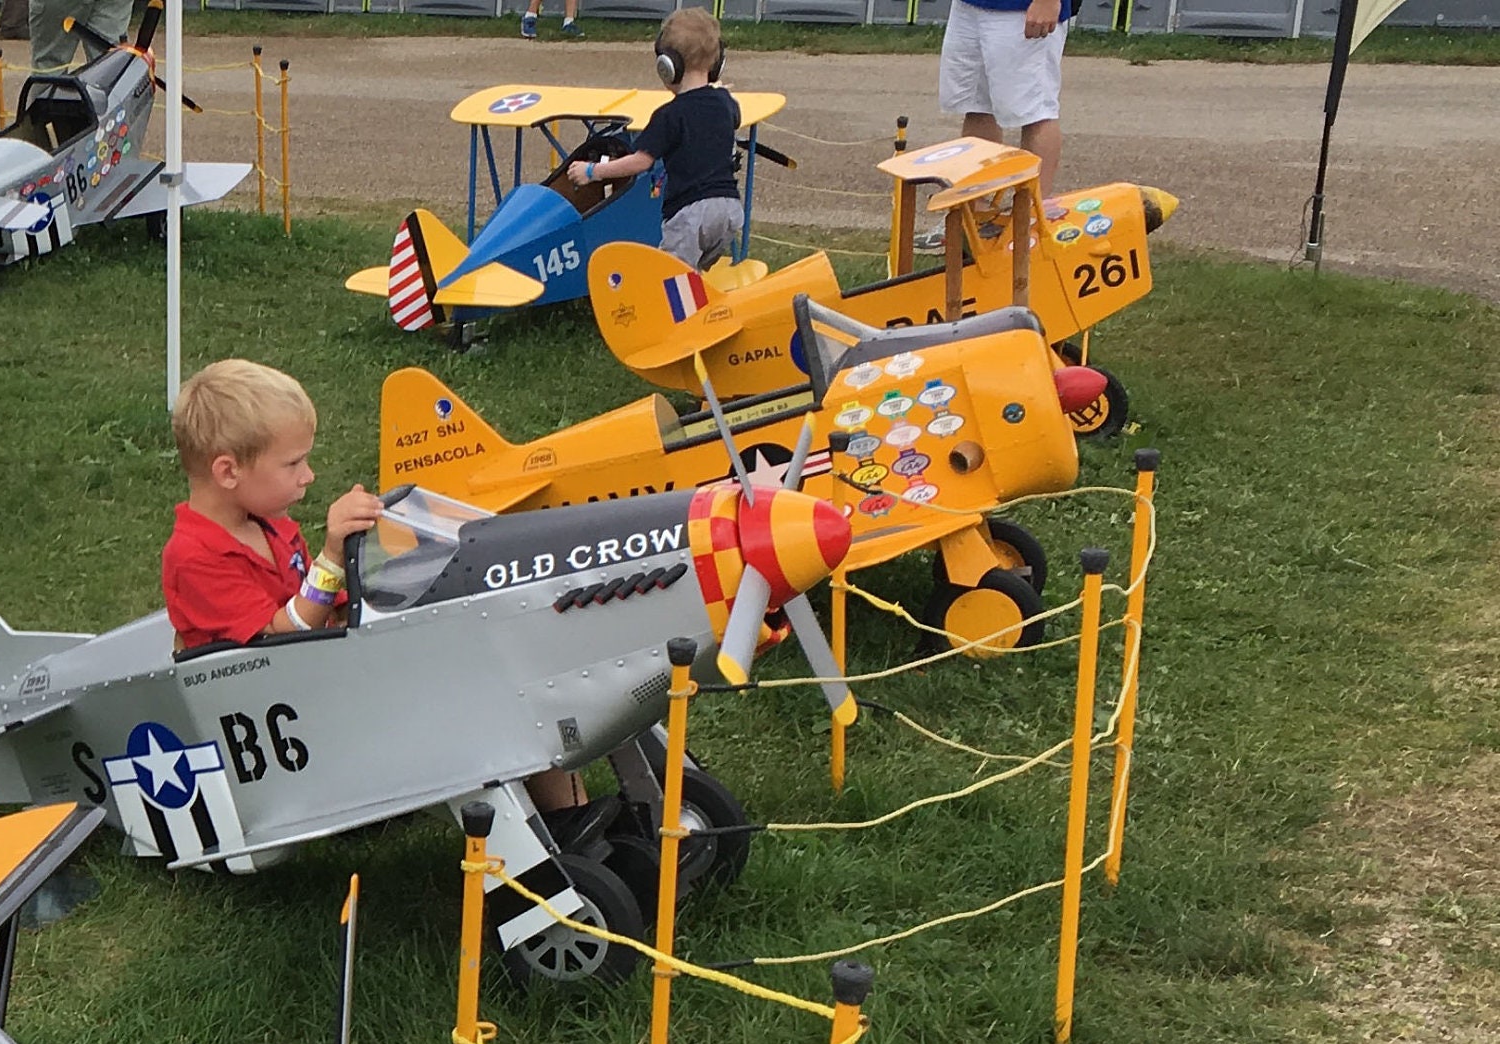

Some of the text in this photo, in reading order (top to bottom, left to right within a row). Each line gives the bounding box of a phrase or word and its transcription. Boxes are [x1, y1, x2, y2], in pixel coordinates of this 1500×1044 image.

[532, 239, 580, 282] 145
[1073, 248, 1140, 298] 261
[395, 420, 465, 448] 4327 SNJ
[394, 442, 486, 475] PENSACOLA
[483, 523, 684, 590] OLD CROW
[183, 656, 271, 688] BUD ANDERSON
[219, 702, 309, 785] B6
